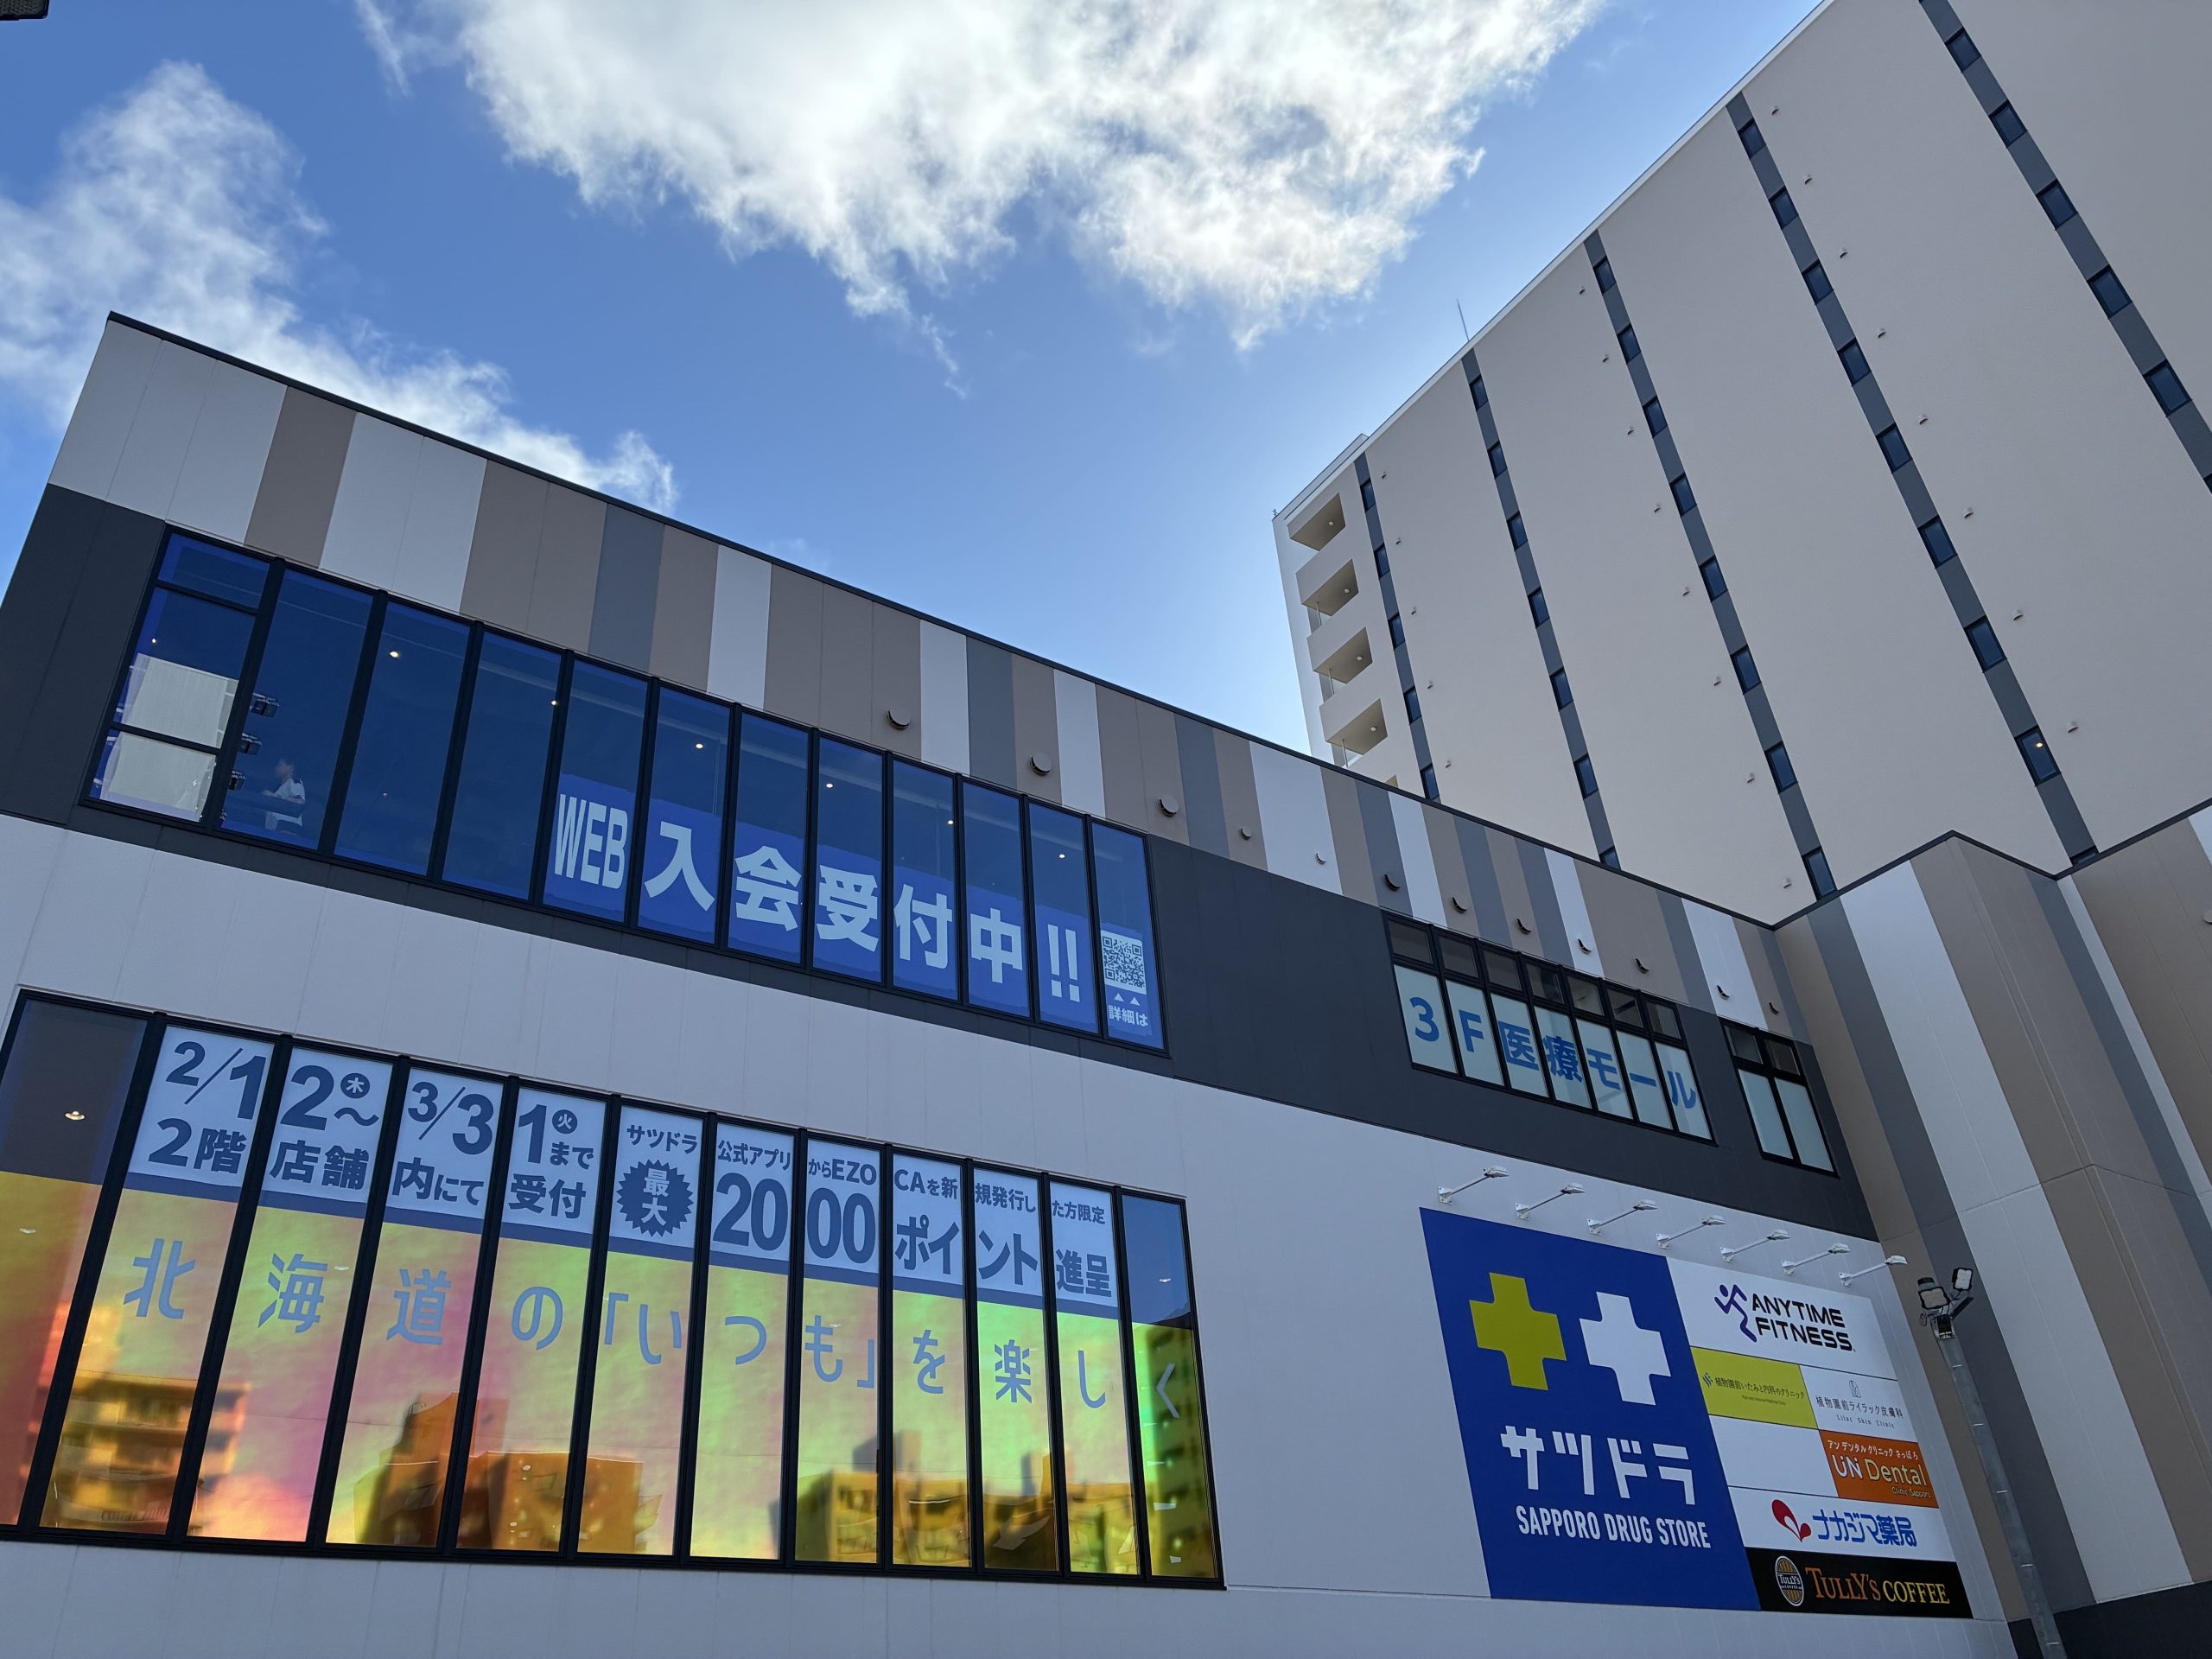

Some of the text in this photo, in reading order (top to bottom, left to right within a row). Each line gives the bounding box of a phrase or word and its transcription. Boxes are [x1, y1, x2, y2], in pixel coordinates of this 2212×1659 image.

[1109, 1005, 1148, 1027] 詳細は
[1751, 1293, 1846, 1328] ANYTIME
[1755, 1316, 1853, 1351] FITNESS
[1815, 1395, 1904, 1418] 植物園前ライラック皮膚科
[1836, 1414, 1853, 1422] Lilac
[1876, 1420, 1895, 1428] Clinic
[1500, 1425, 1695, 1505] サツドラ
[1864, 1458, 1927, 1485] Dental
[1515, 1504, 1712, 1549] SAPPORO DRUG STORE
[1812, 1509, 1917, 1547] ナカジマ薬局
[1882, 1580, 1950, 1604] COFFEE
